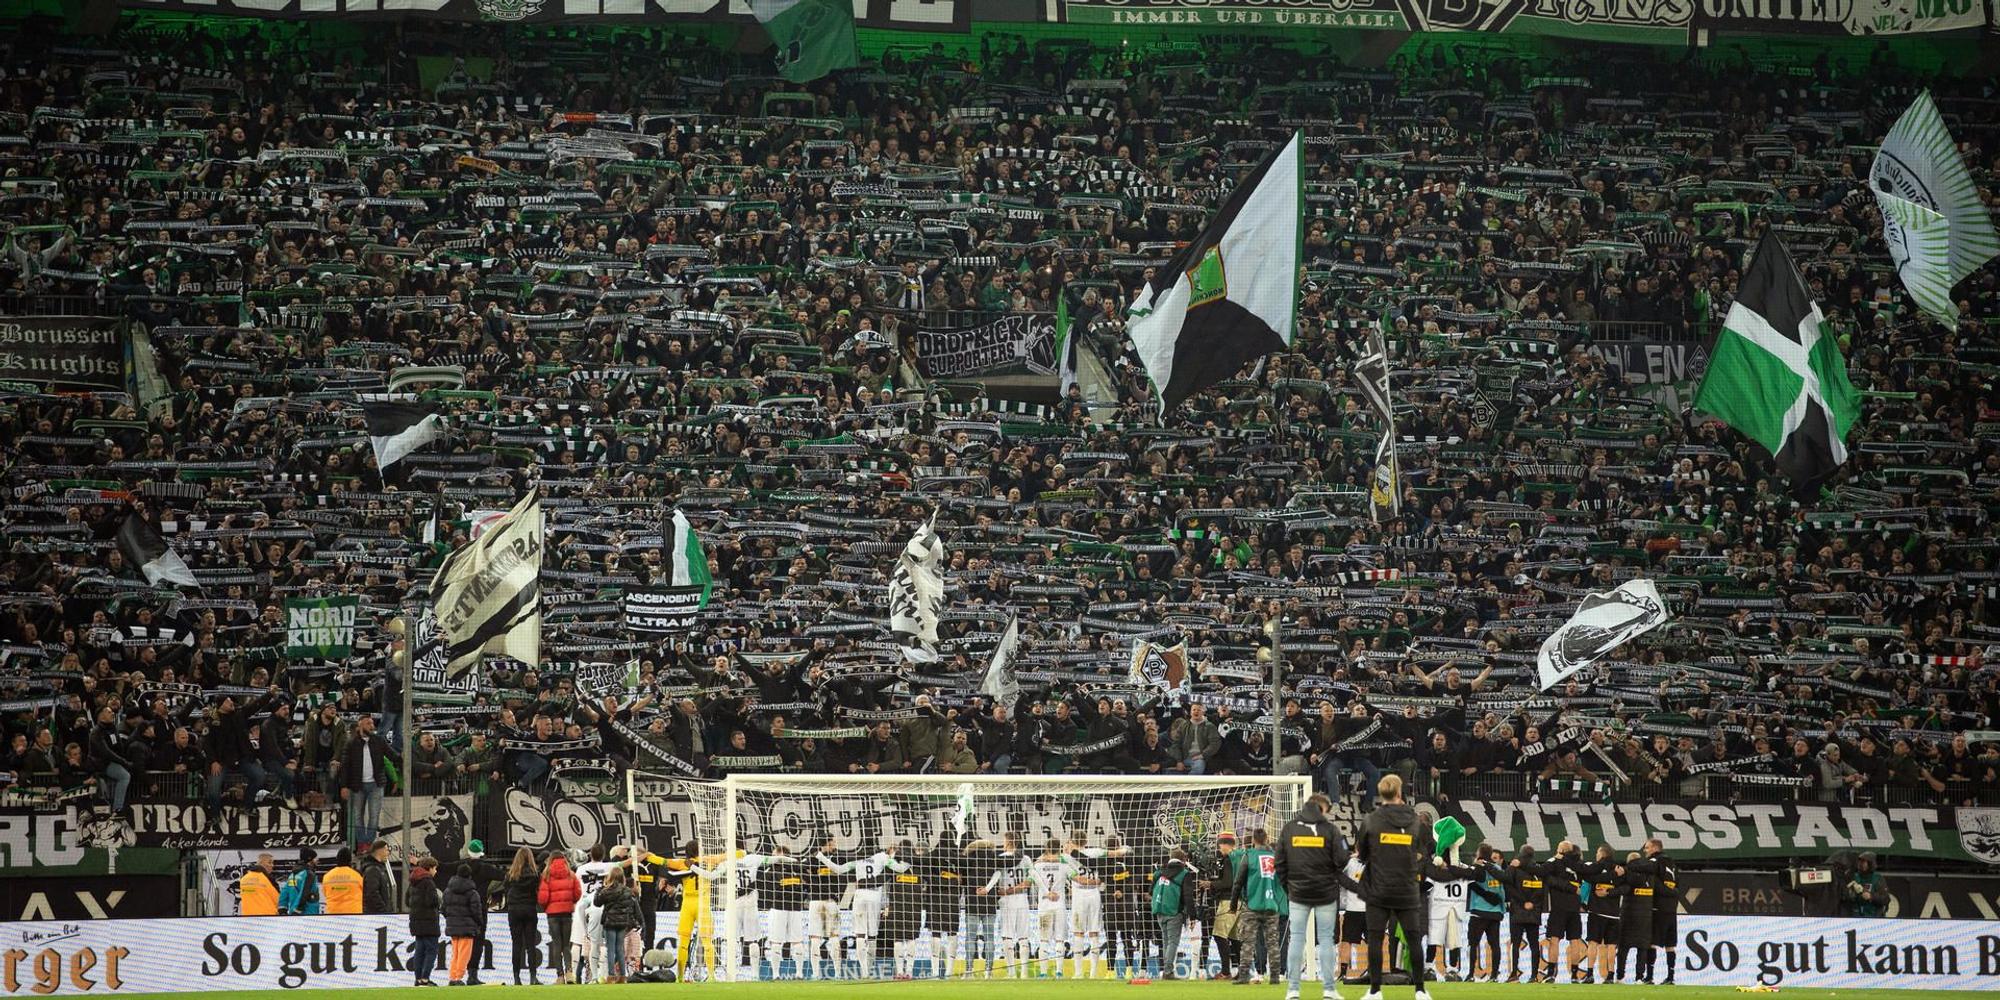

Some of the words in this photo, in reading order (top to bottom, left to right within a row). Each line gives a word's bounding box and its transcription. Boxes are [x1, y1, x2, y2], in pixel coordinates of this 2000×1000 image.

[1111, 10, 1199, 24] IMMER
[1216, 10, 1261, 24] UND
[1275, 9, 1393, 27] ÜBERALL!
[1, 322, 116, 345] Borussen
[917, 319, 1025, 358] DROPKICK
[0, 356, 121, 377] Knights
[928, 341, 1016, 377] SUPPORTERS
[289, 607, 354, 628] NORD
[626, 615, 679, 627] ULTRA
[611, 720, 701, 778] SOTTOCULTURA
[130, 803, 340, 835] FRONTLINE
[1458, 800, 1938, 852] VITUSSTADT
[161, 836, 229, 849] Ackerbande
[263, 835, 293, 849] seit
[299, 832, 341, 847] 2006
[1444, 883, 1462, 898] 10
[1722, 887, 1784, 905] BRAX
[201, 932, 261, 977] So
[278, 933, 359, 989] gut
[1685, 929, 1740, 972] So
[1757, 935, 1830, 986] gut
[1846, 929, 1961, 976] kann
